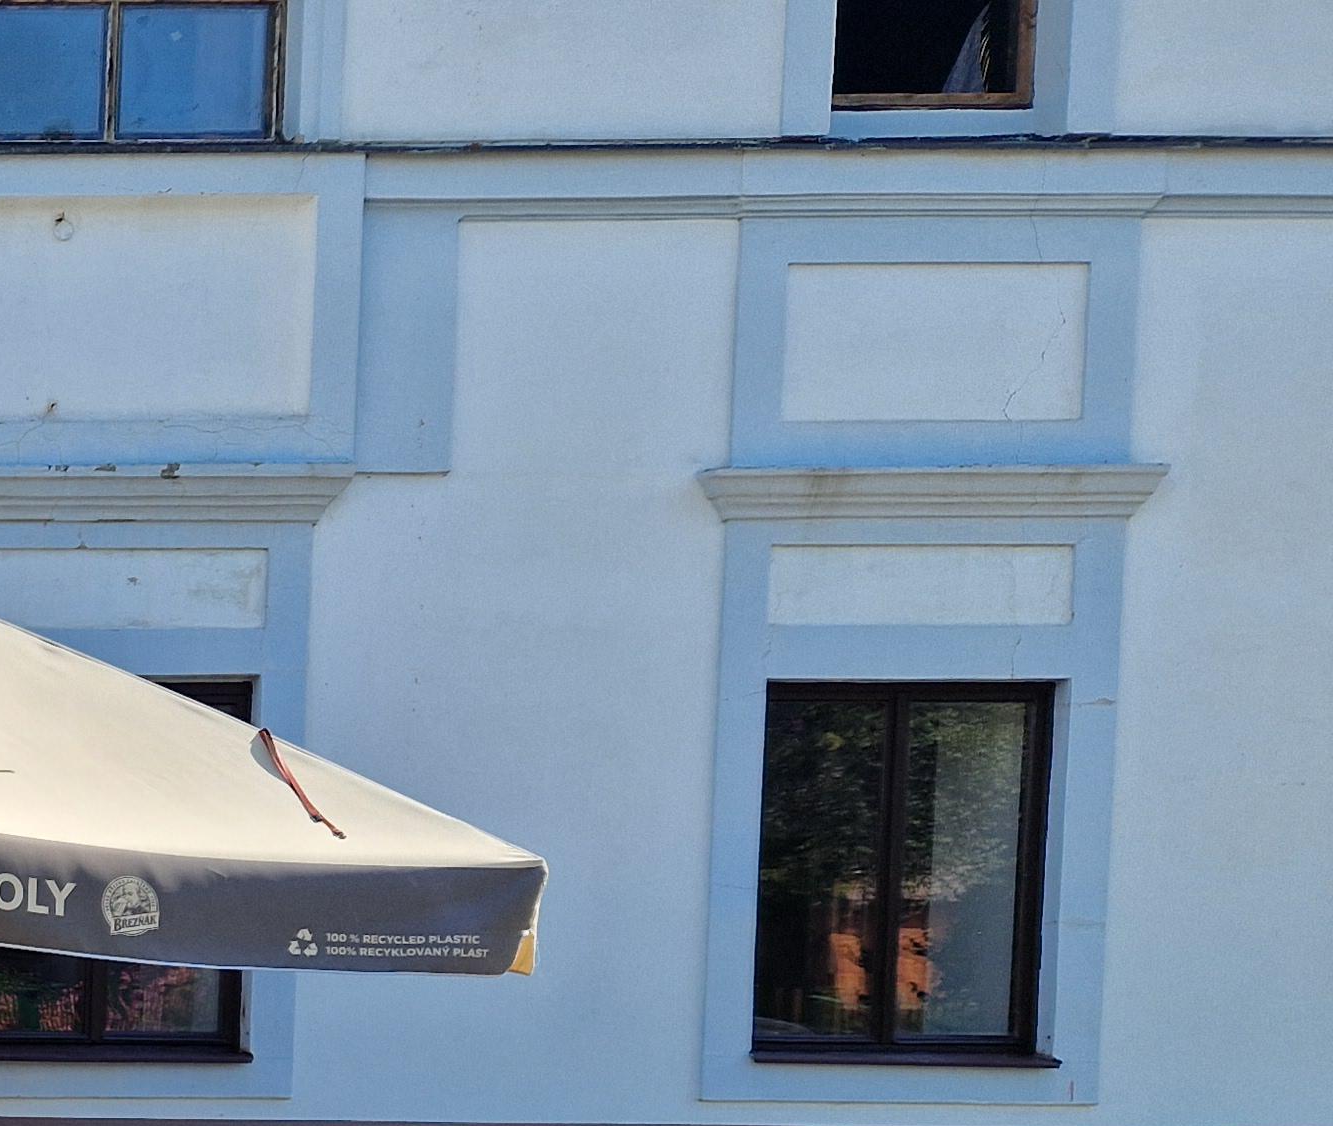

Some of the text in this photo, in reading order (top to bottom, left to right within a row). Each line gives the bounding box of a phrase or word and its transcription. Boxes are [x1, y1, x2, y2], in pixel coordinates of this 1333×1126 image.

[325, 932, 347, 943] 100
[362, 934, 426, 945] RECYCLED
[428, 935, 481, 945] PLASTIC
[324, 945, 490, 958] 100% RECYKLOVANÝ PLAST
